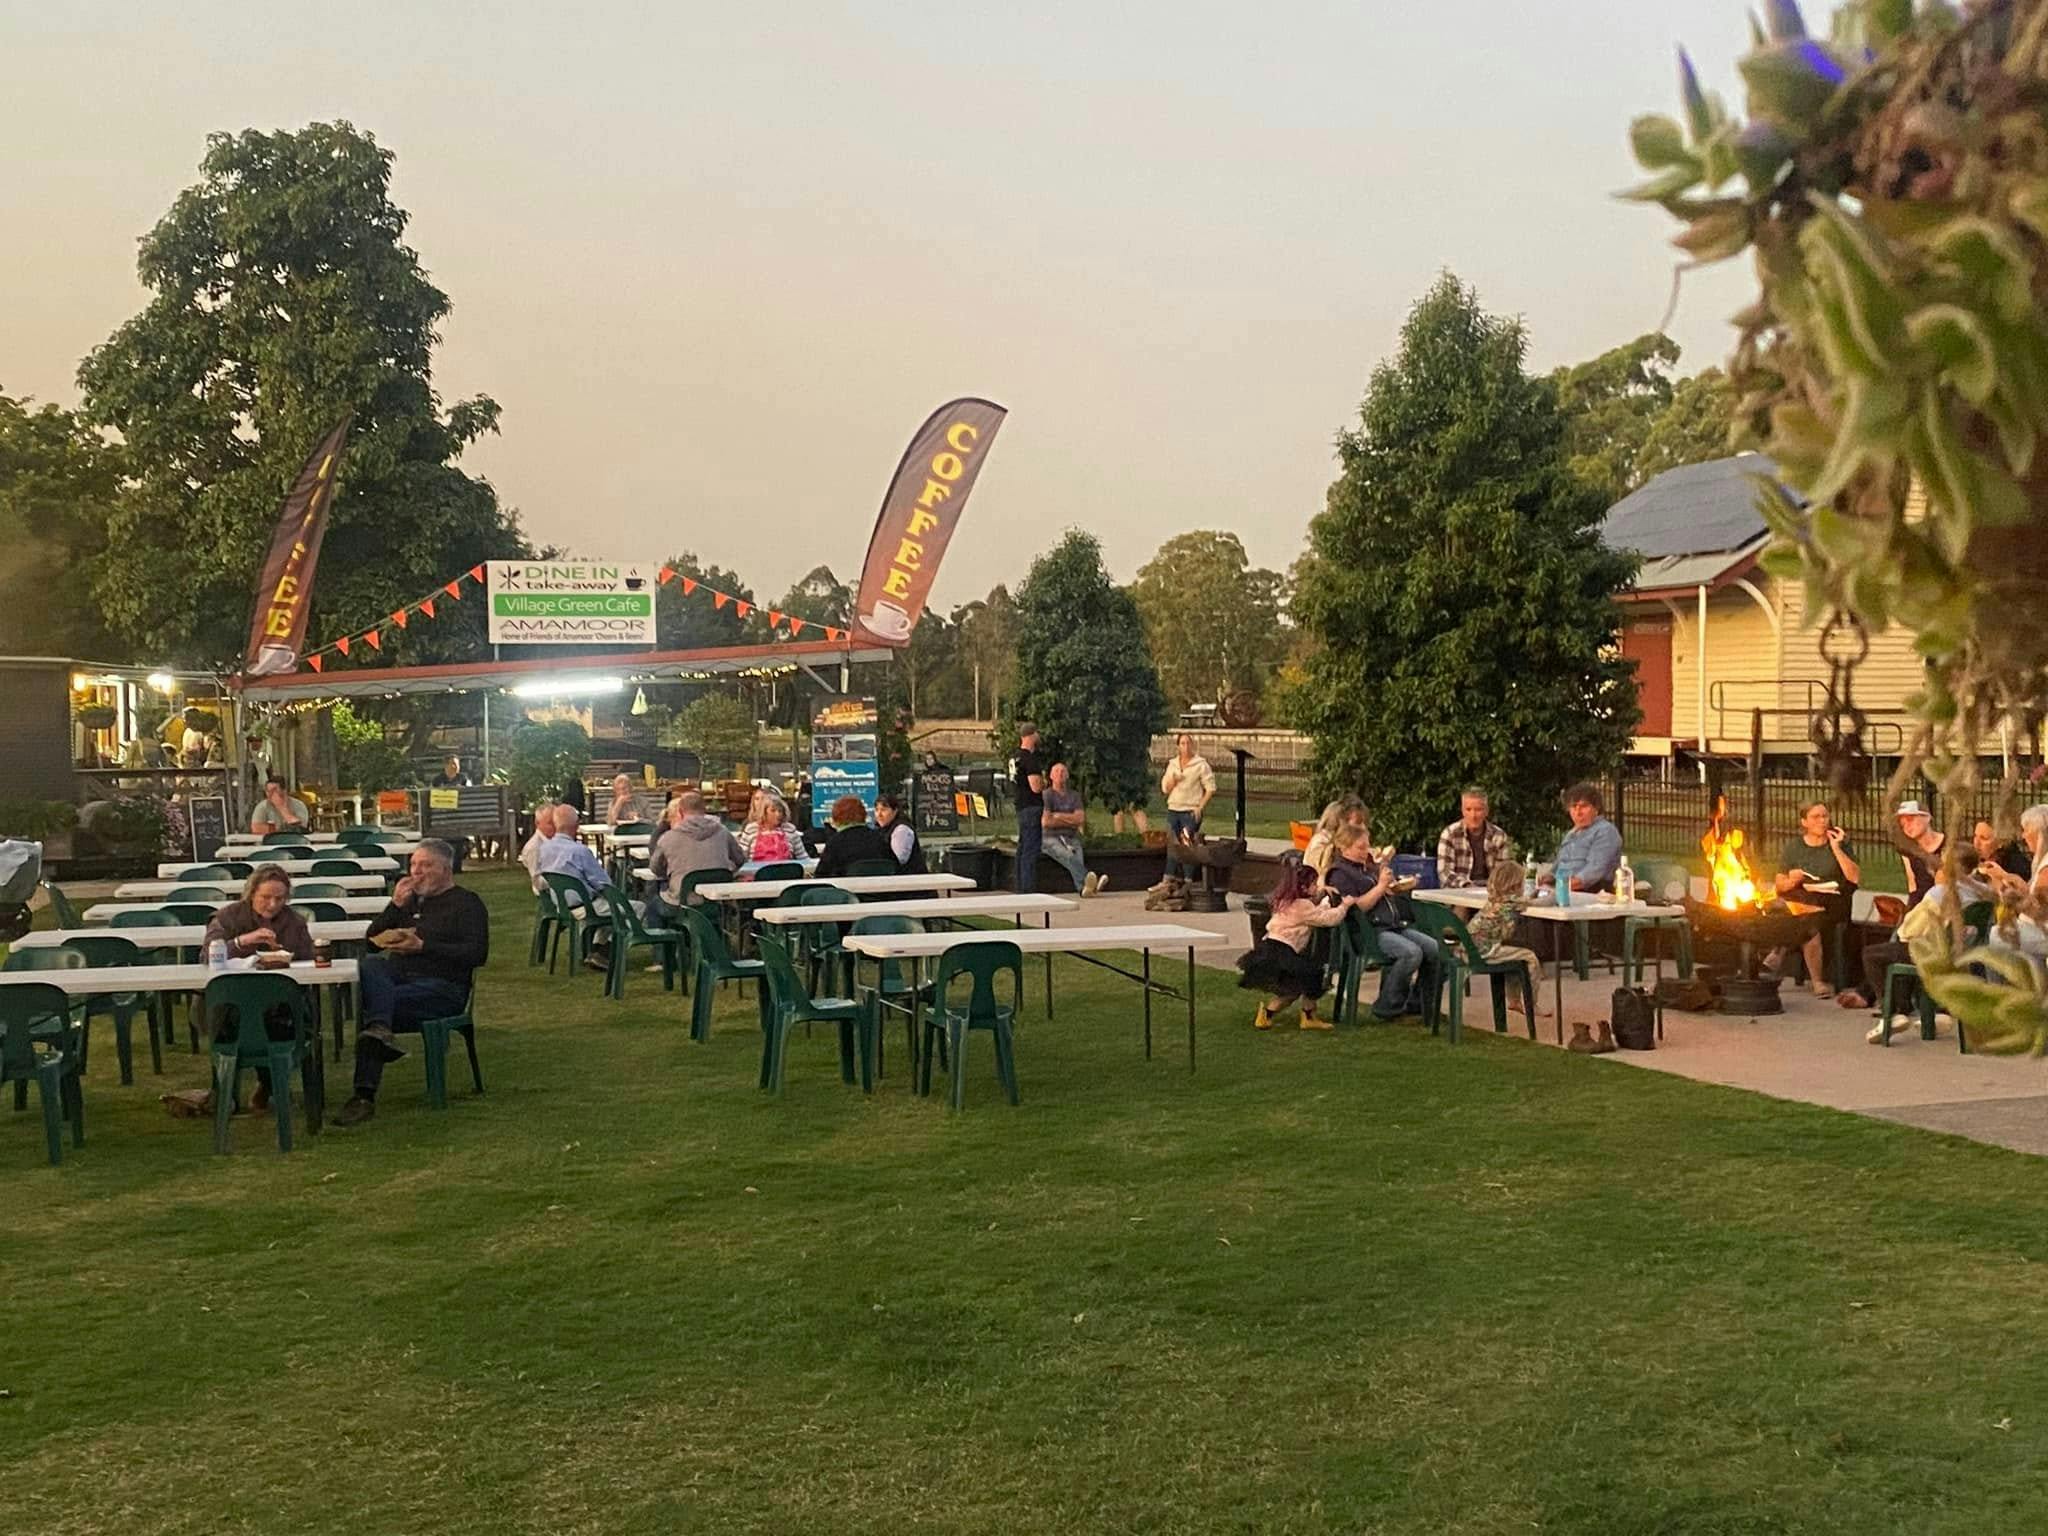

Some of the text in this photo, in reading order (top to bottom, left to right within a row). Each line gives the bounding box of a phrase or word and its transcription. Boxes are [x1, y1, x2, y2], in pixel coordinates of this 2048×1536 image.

[883, 422, 977, 600] COFFEE
[524, 566, 619, 579] DINE IN
[526, 580, 617, 591] take-away
[505, 598, 557, 614] Village
[558, 598, 604, 612] Green
[500, 619, 645, 631] AMAMOOR
[501, 632, 520, 640] Home
[521, 632, 528, 640] of
